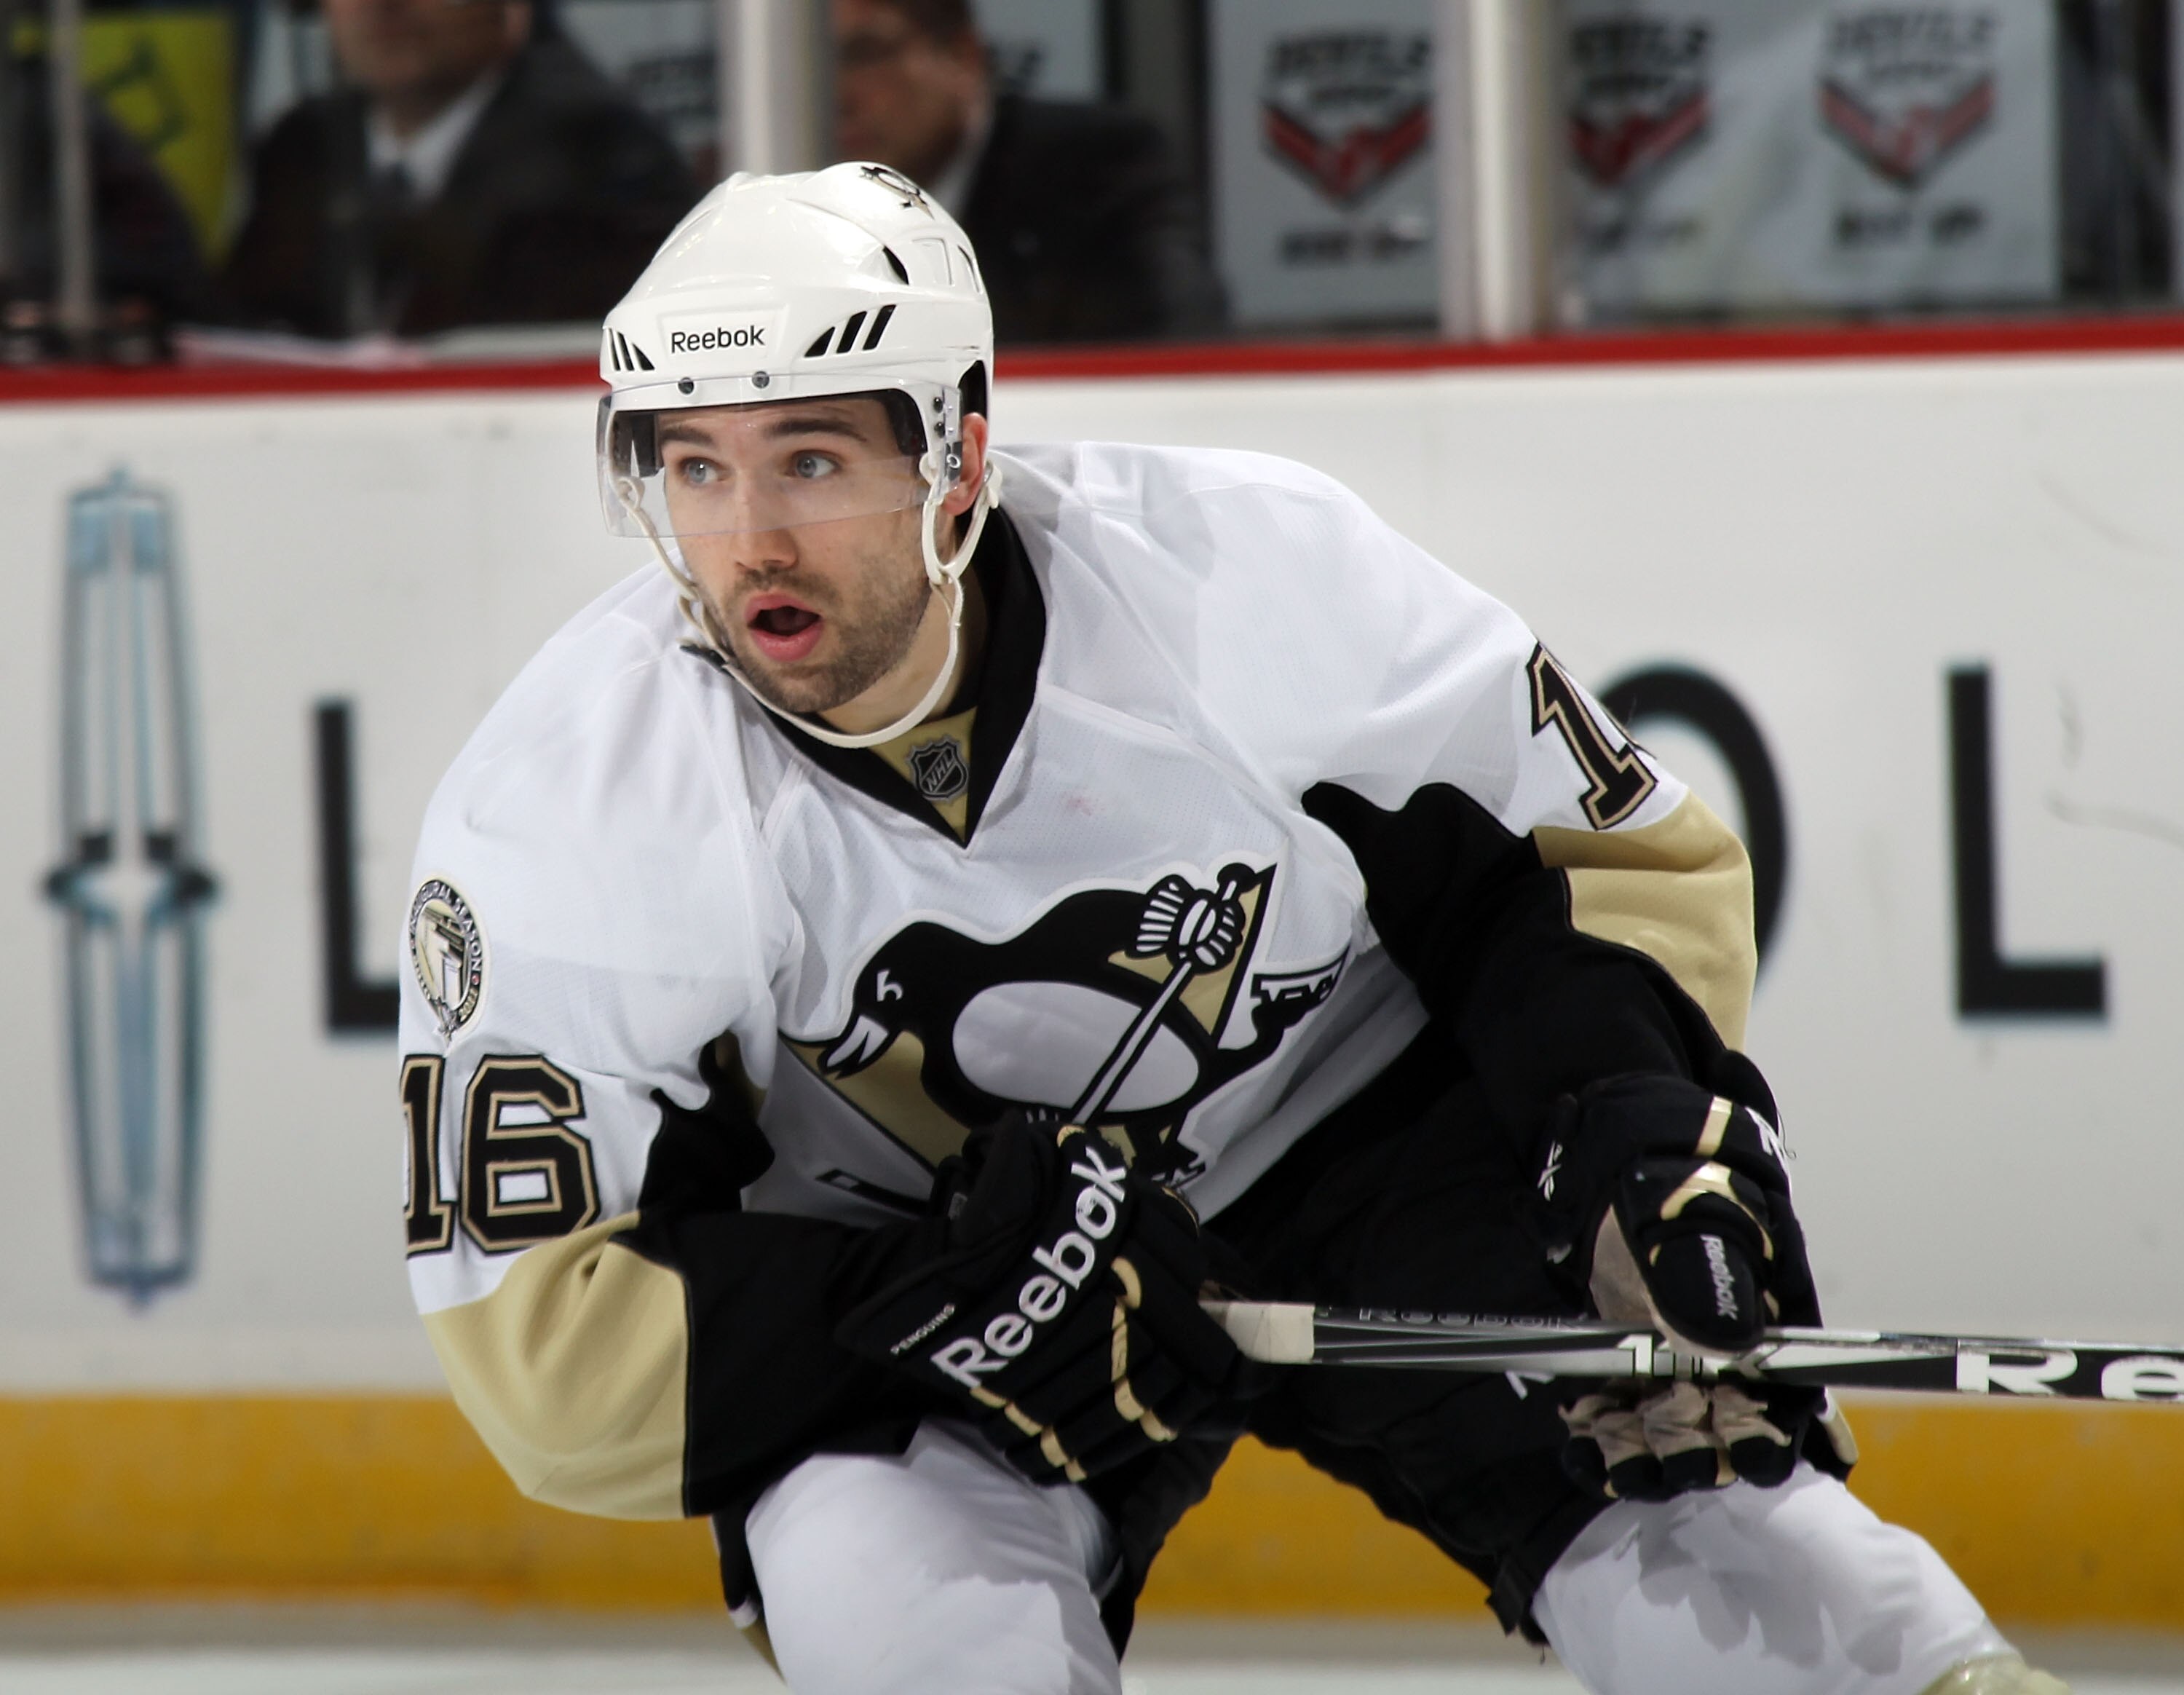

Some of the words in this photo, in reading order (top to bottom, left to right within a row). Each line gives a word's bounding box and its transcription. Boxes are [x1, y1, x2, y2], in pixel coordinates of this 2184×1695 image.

[670, 325, 765, 354] Reebok
[925, 751, 954, 792] NHL
[454, 900, 483, 972] SEASON
[400, 1054, 601, 1260] 16
[930, 1146, 1126, 1388] Reebok
[1699, 1233, 1742, 1322] Reebok
[1956, 1348, 2184, 1402] Re
